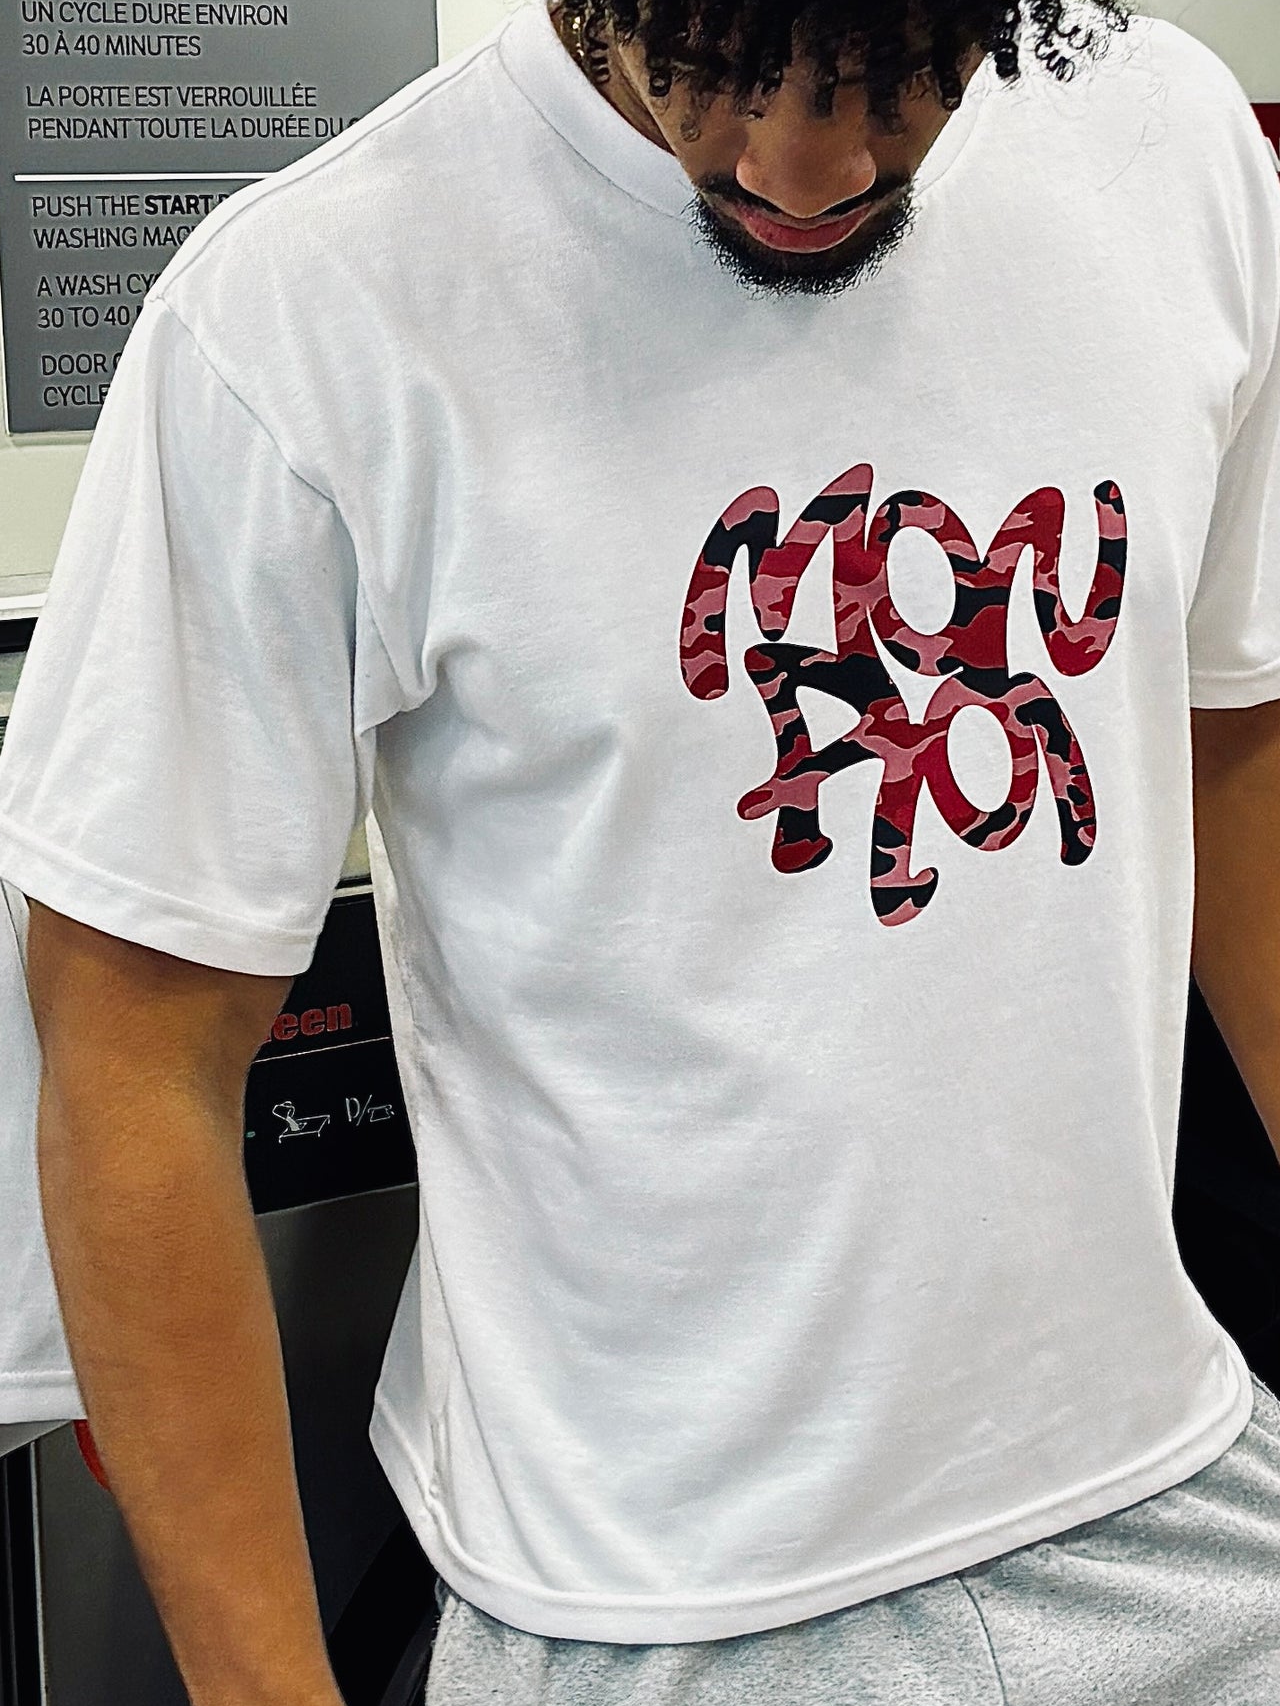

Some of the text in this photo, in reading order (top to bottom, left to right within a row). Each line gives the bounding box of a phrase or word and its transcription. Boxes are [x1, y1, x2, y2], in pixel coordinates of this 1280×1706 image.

[21, 1, 288, 26] UN CYCLE DURE ENVIRON
[22, 30, 202, 57] 30 À 40 MINUTES
[26, 82, 317, 108] LA PORTE EST VERROUILLÉE
[28, 117, 132, 140] PENDANT
[134, 118, 207, 140] TOUTE
[211, 118, 237, 139] LA
[241, 114, 311, 139] DURÉE
[314, 117, 343, 138] DU
[32, 196, 92, 218] PUSH
[95, 195, 140, 217] THE
[144, 194, 213, 216] START
[33, 227, 137, 249] WASHING
[37, 275, 53, 298] A
[56, 274, 120, 296] WASH
[37, 307, 64, 329] 30
[68, 306, 99, 328] TO
[104, 305, 130, 326] 40
[41, 353, 108, 377] DOOR
[265, 1002, 353, 1043] een
